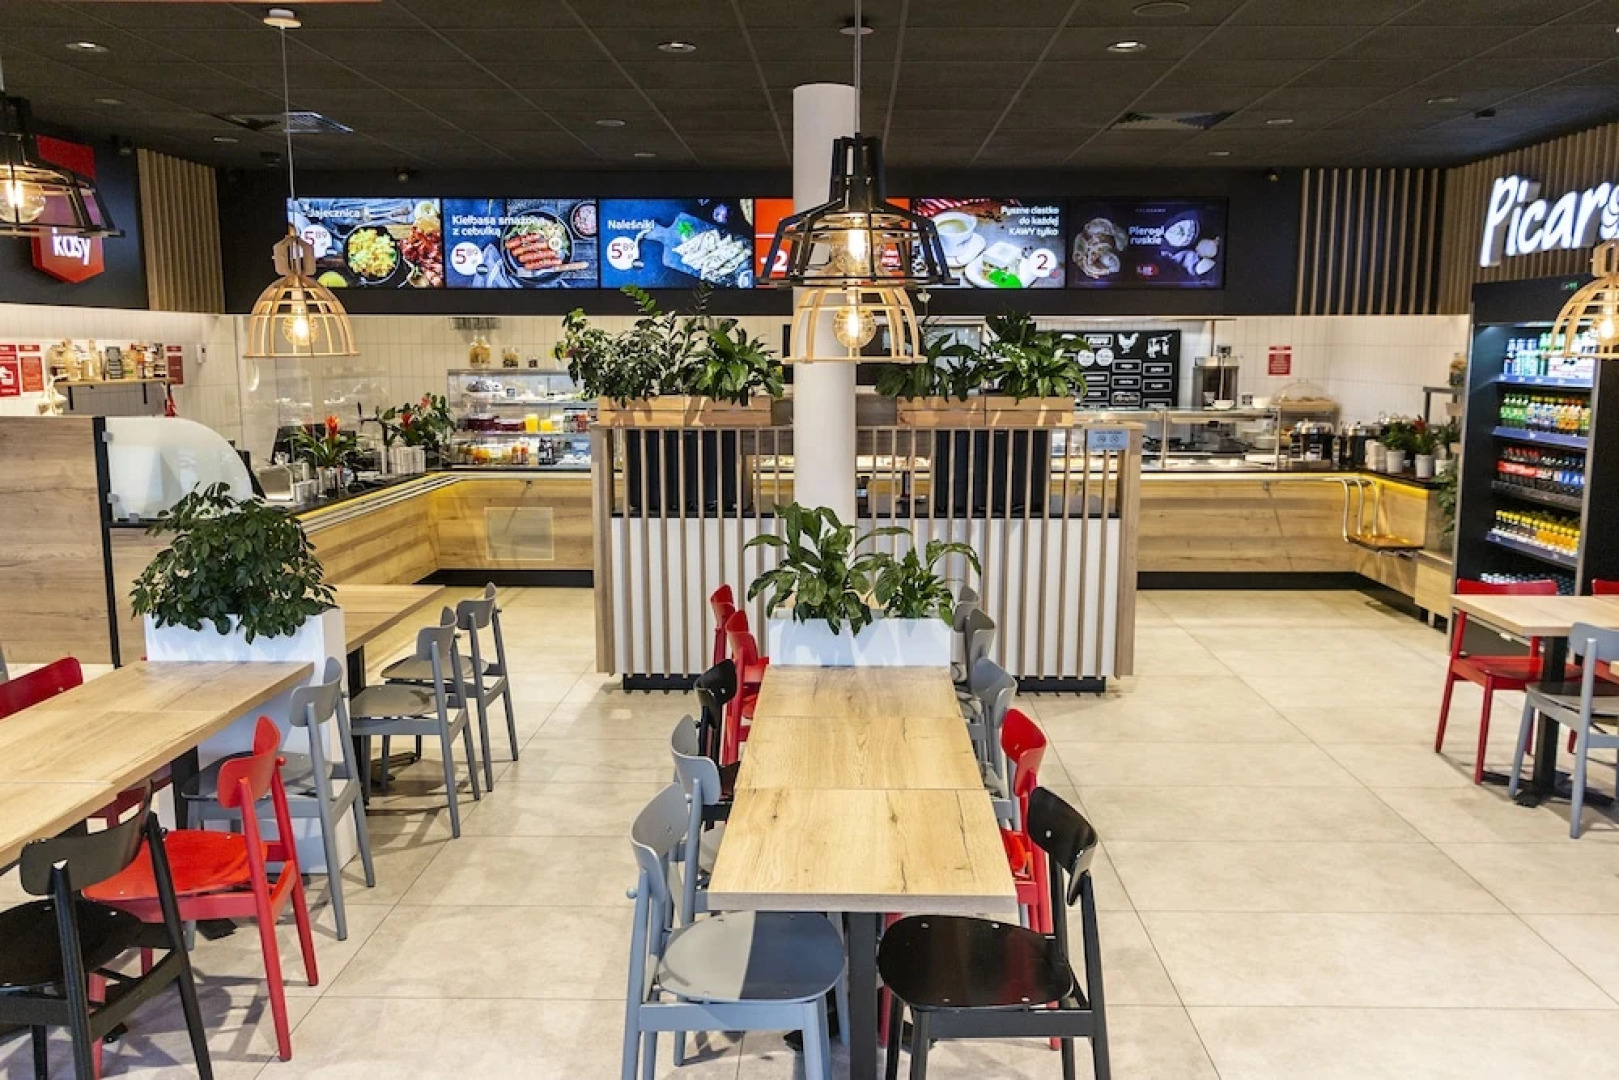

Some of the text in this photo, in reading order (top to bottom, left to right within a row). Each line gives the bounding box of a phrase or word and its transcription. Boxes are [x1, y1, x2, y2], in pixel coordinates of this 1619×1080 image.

[307, 208, 360, 220] Jajecznica
[607, 219, 655, 231] Naleśniki
[1019, 216, 1031, 225] do
[452, 228, 459, 236] z
[1009, 226, 1036, 236] KAWY
[455, 248, 467, 265] 5
[612, 242, 623, 259] 5
[1036, 253, 1049, 270] 2
